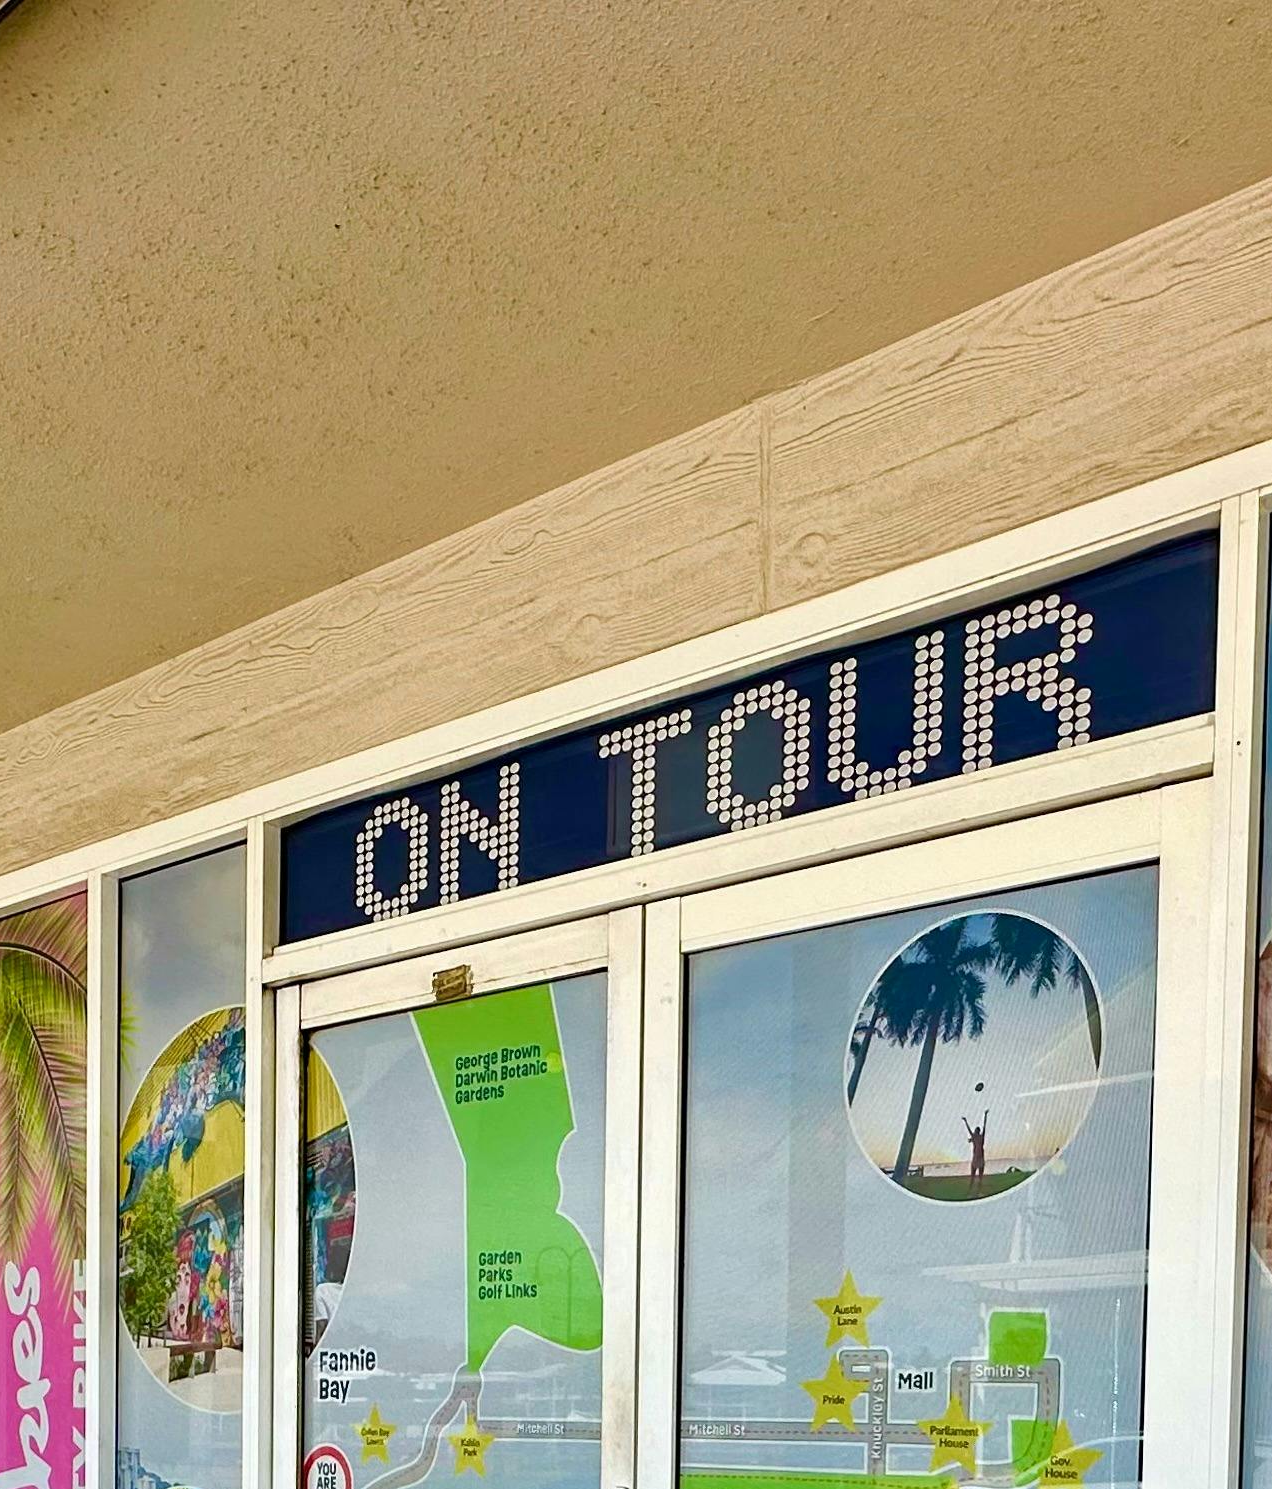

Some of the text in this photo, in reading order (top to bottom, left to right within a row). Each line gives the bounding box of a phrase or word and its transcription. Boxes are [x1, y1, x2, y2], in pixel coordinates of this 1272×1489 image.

[354, 594, 1093, 923] ON TOUR
[455, 1045, 541, 1071] George Brown
[455, 1060, 548, 1088] Darwin Botanic
[455, 1085, 505, 1104] Gardens
[478, 1250, 522, 1267] Garden
[478, 1267, 513, 1283] Parks
[478, 1282, 538, 1300] Golf Links
[833, 1304, 862, 1316] Austin
[837, 1316, 858, 1326] Lane
[319, 1348, 376, 1372] Fannie
[974, 1364, 1031, 1377] Smith St
[872, 1377, 884, 1392] St
[898, 1371, 934, 1389] Mall
[319, 1378, 350, 1403] Bay
[822, 1394, 845, 1405] Pride
[517, 1422, 565, 1434] Mitchell St
[689, 1424, 746, 1436] Mitchell St
[939, 1438, 969, 1449] House
[316, 1462, 337, 1476] YOU
[1045, 1468, 1078, 1480] House
[316, 1476, 337, 1489] ARE
